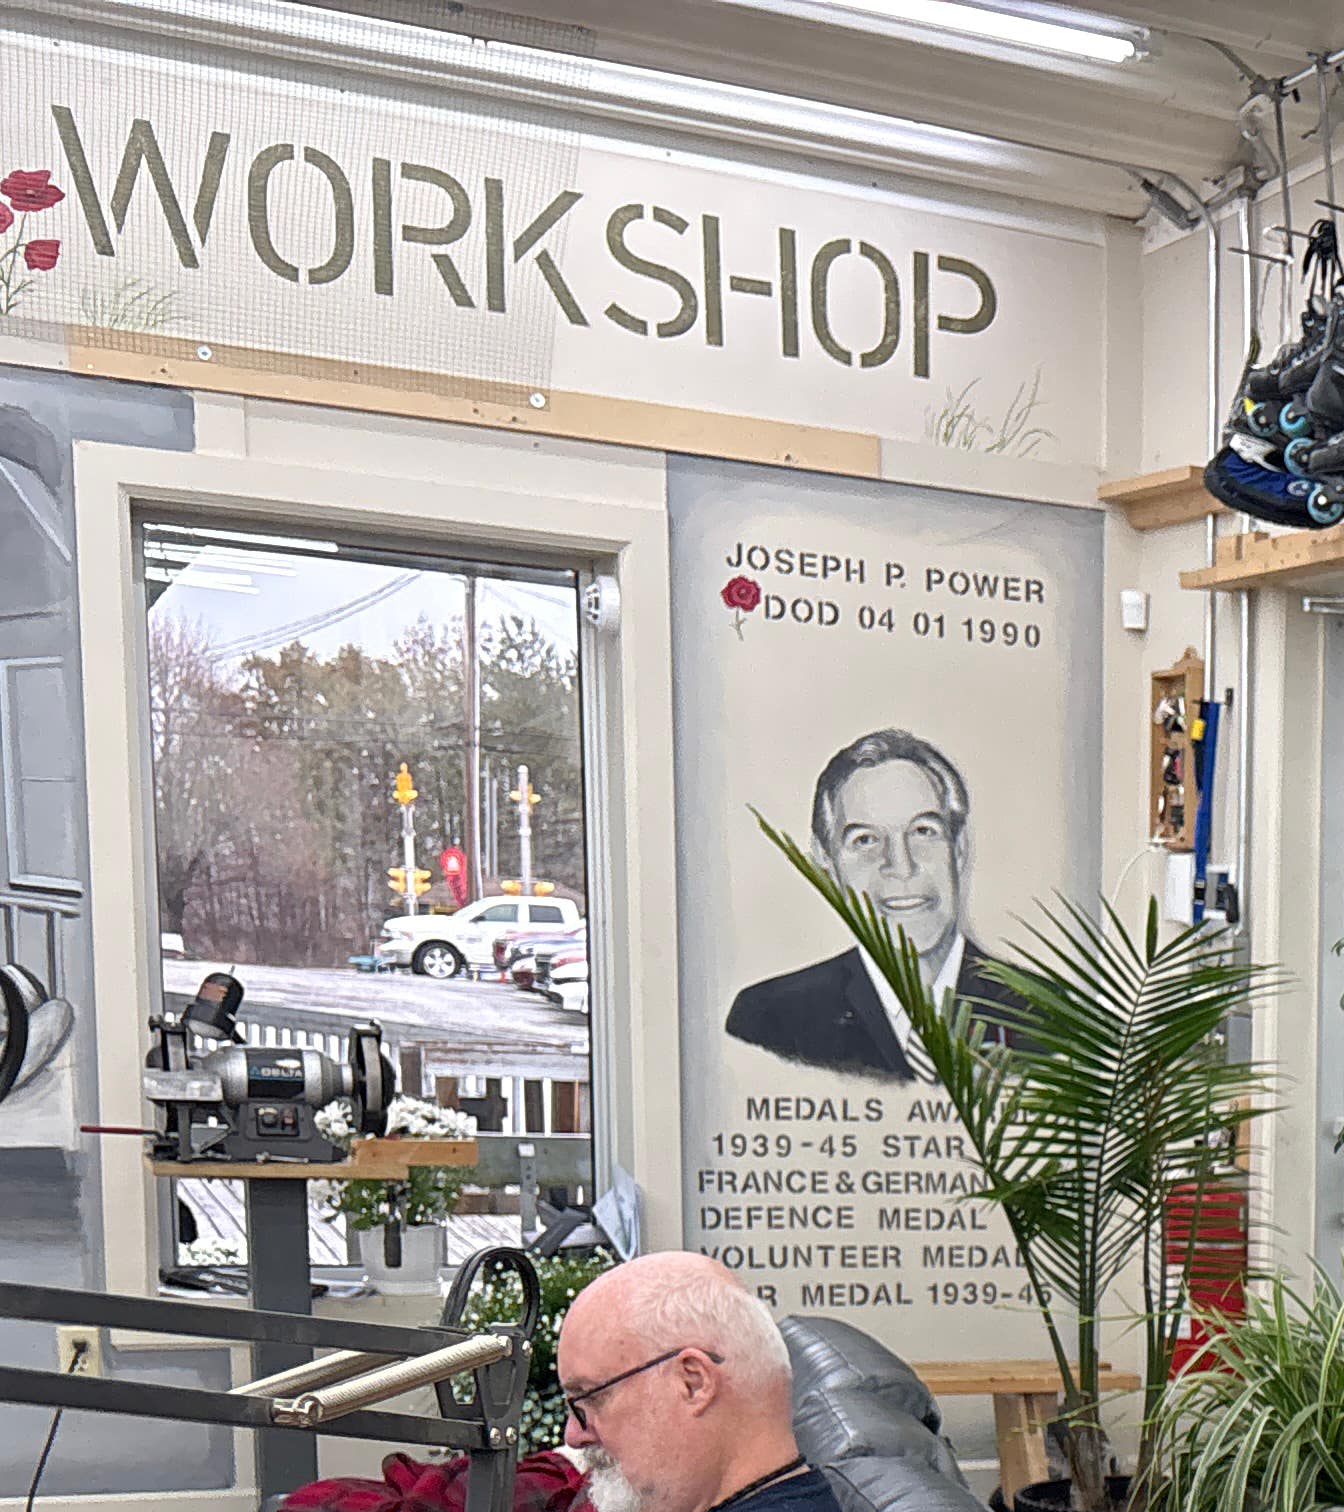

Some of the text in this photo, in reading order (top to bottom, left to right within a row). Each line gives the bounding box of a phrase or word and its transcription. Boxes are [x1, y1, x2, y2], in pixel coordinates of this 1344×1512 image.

[50, 104, 998, 380] WORKSHOP
[726, 543, 1045, 604] JOSEPH P. POWER
[765, 594, 1041, 648] DOD 04 01 1990
[747, 1097, 884, 1122] MEDALS
[712, 1132, 965, 1159] 1939-45 STAR
[862, 1170, 988, 1195] GERMAN
[701, 1205, 987, 1231] DEFENCE MEDAL
[701, 1244, 1026, 1269] VOLUNTEER MEDAL
[802, 1283, 913, 1307] MEDAL
